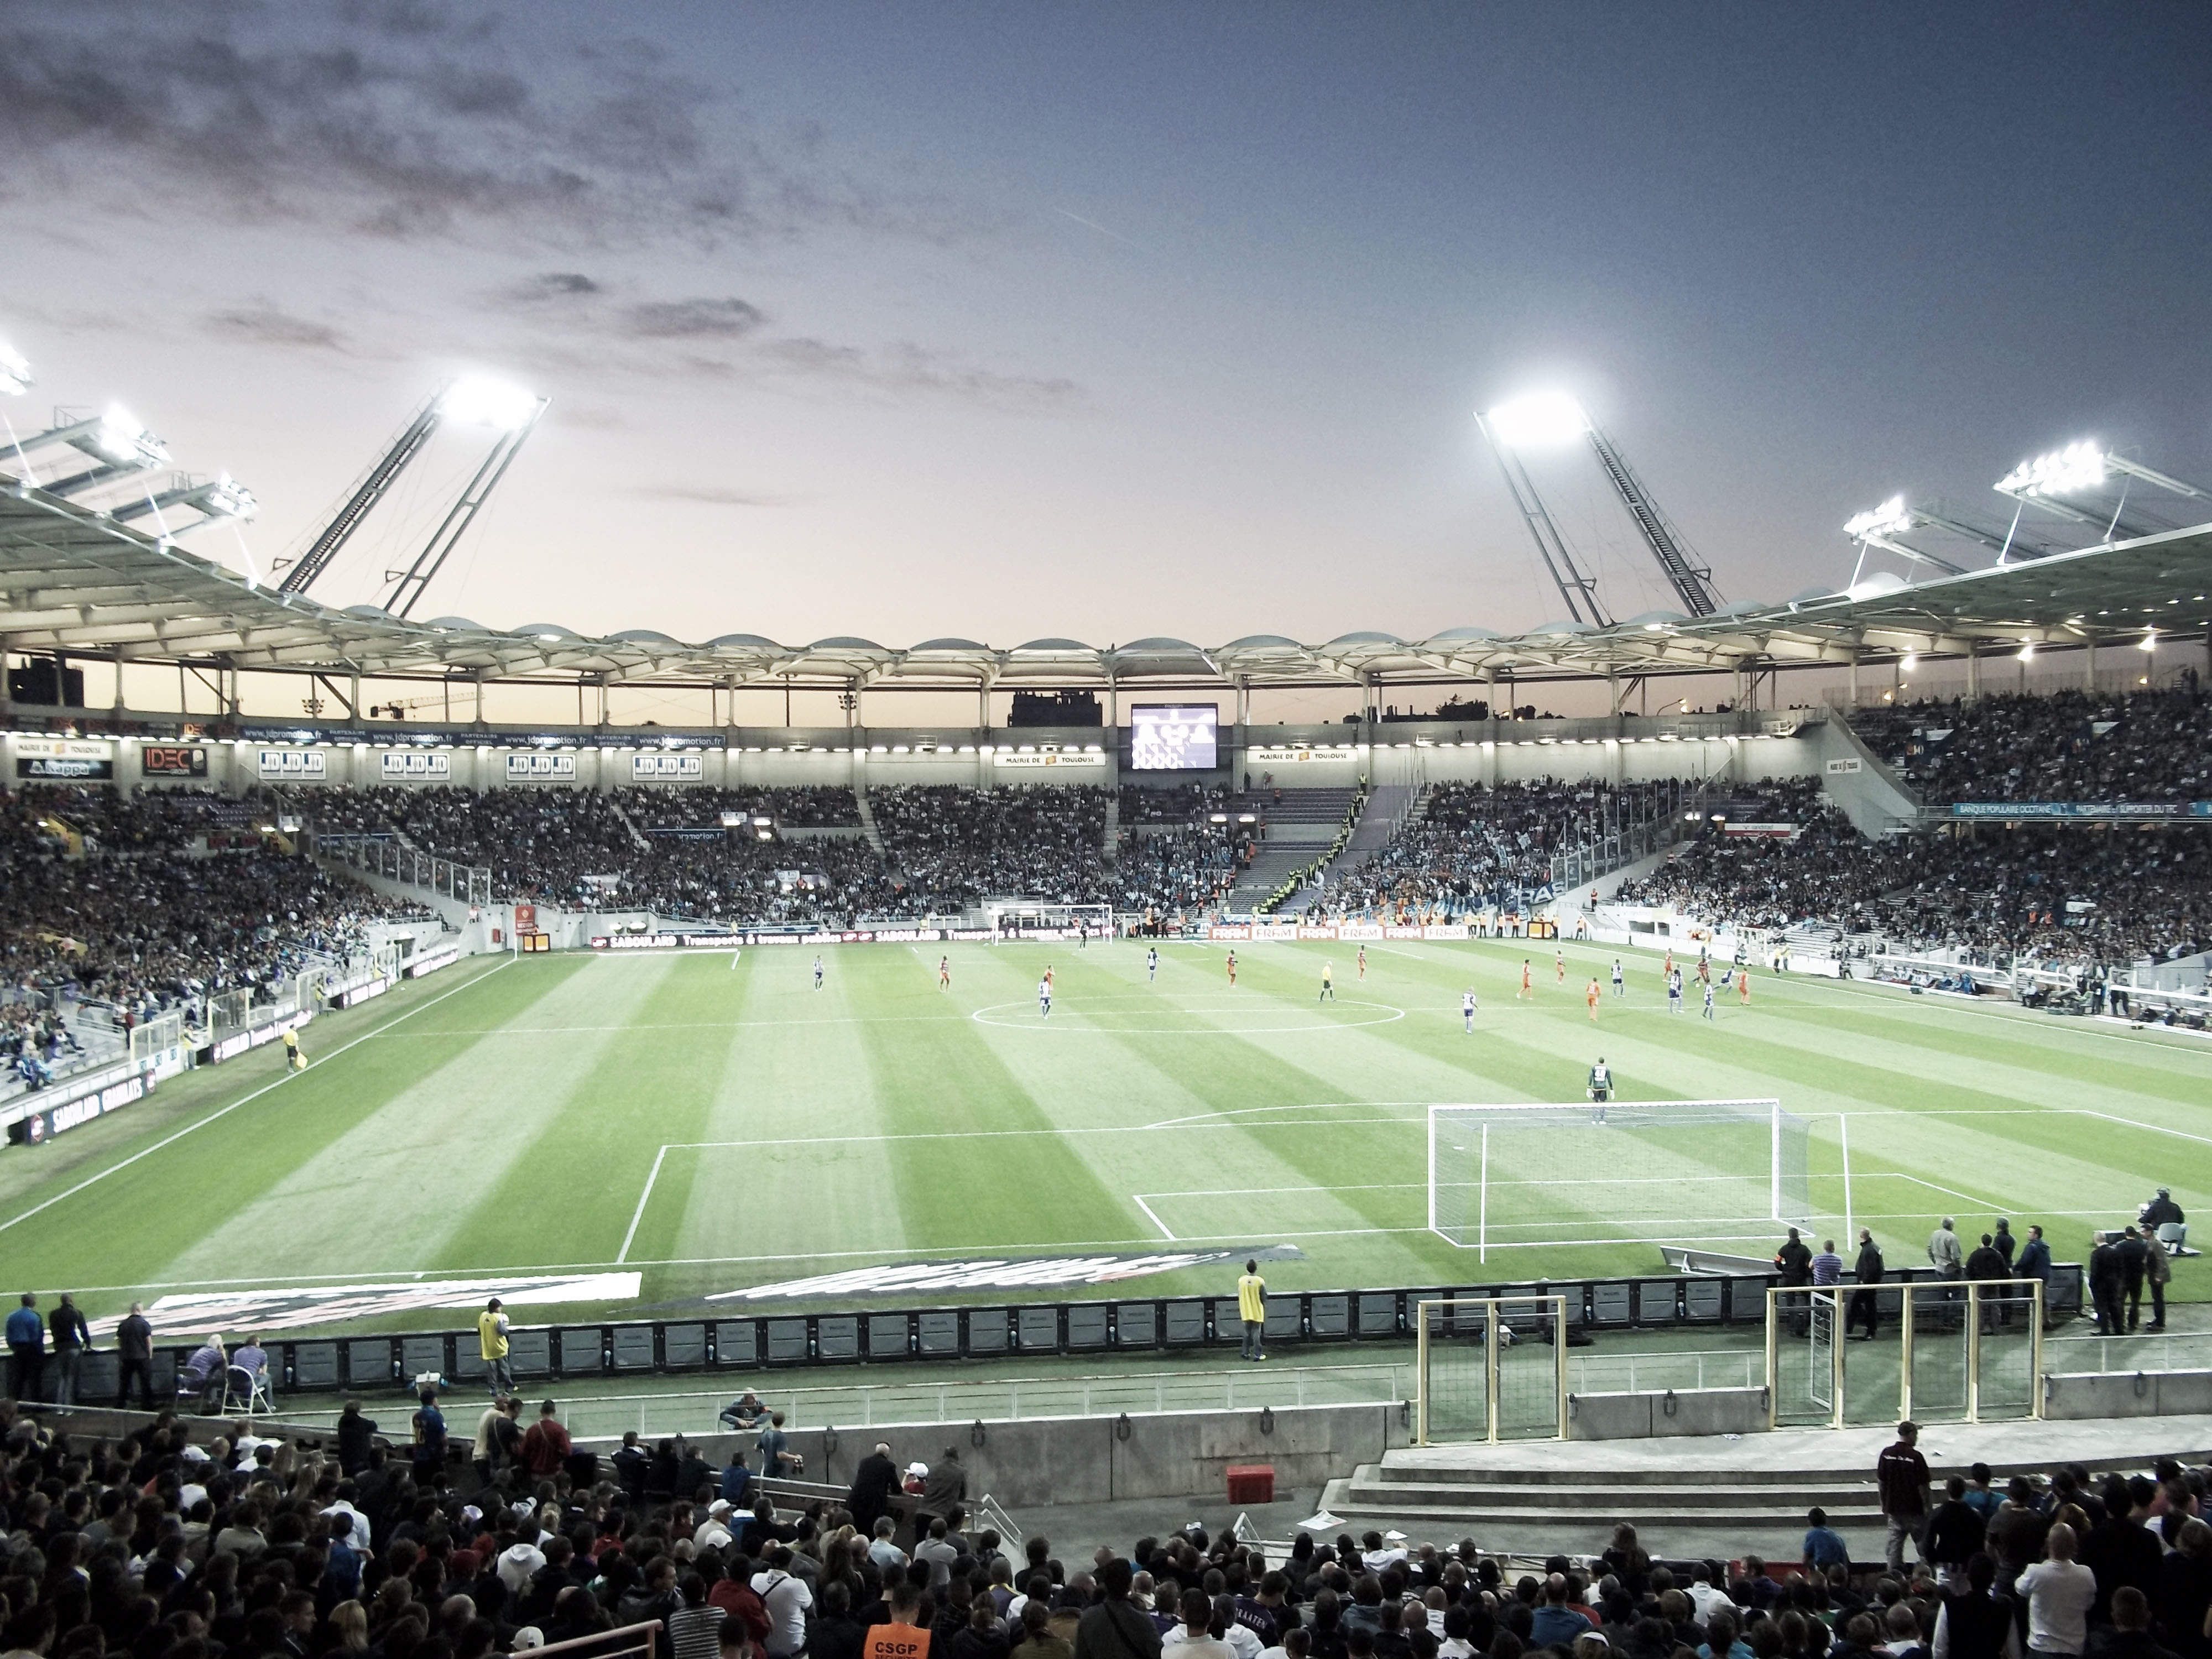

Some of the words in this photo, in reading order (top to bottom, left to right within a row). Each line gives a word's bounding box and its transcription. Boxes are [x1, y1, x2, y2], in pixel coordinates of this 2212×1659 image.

[373, 732, 453, 743] www.jdpromotion.fr
[505, 735, 586, 745] www.jdpromotion.fr
[639, 736, 721, 746] www.jdpromotion.fr
[147, 748, 190, 768] IDEC
[1960, 805, 1986, 814] BANQUE
[876, 930, 941, 942] SABOULARD
[1212, 927, 1249, 938] FRAM
[1256, 928, 1291, 938] FRAM
[1299, 927, 1335, 938] FRAM
[1343, 928, 1378, 938] FRAM
[1385, 927, 1422, 938] FRAM
[1429, 928, 1463, 938] FRAM
[610, 935, 677, 948] SABOULARD
[682, 933, 744, 947] Transports
[746, 933, 755, 945] &
[757, 935, 799, 944] travaux
[801, 932, 842, 945] publics
[875, 1642, 917, 1655] CSGP
